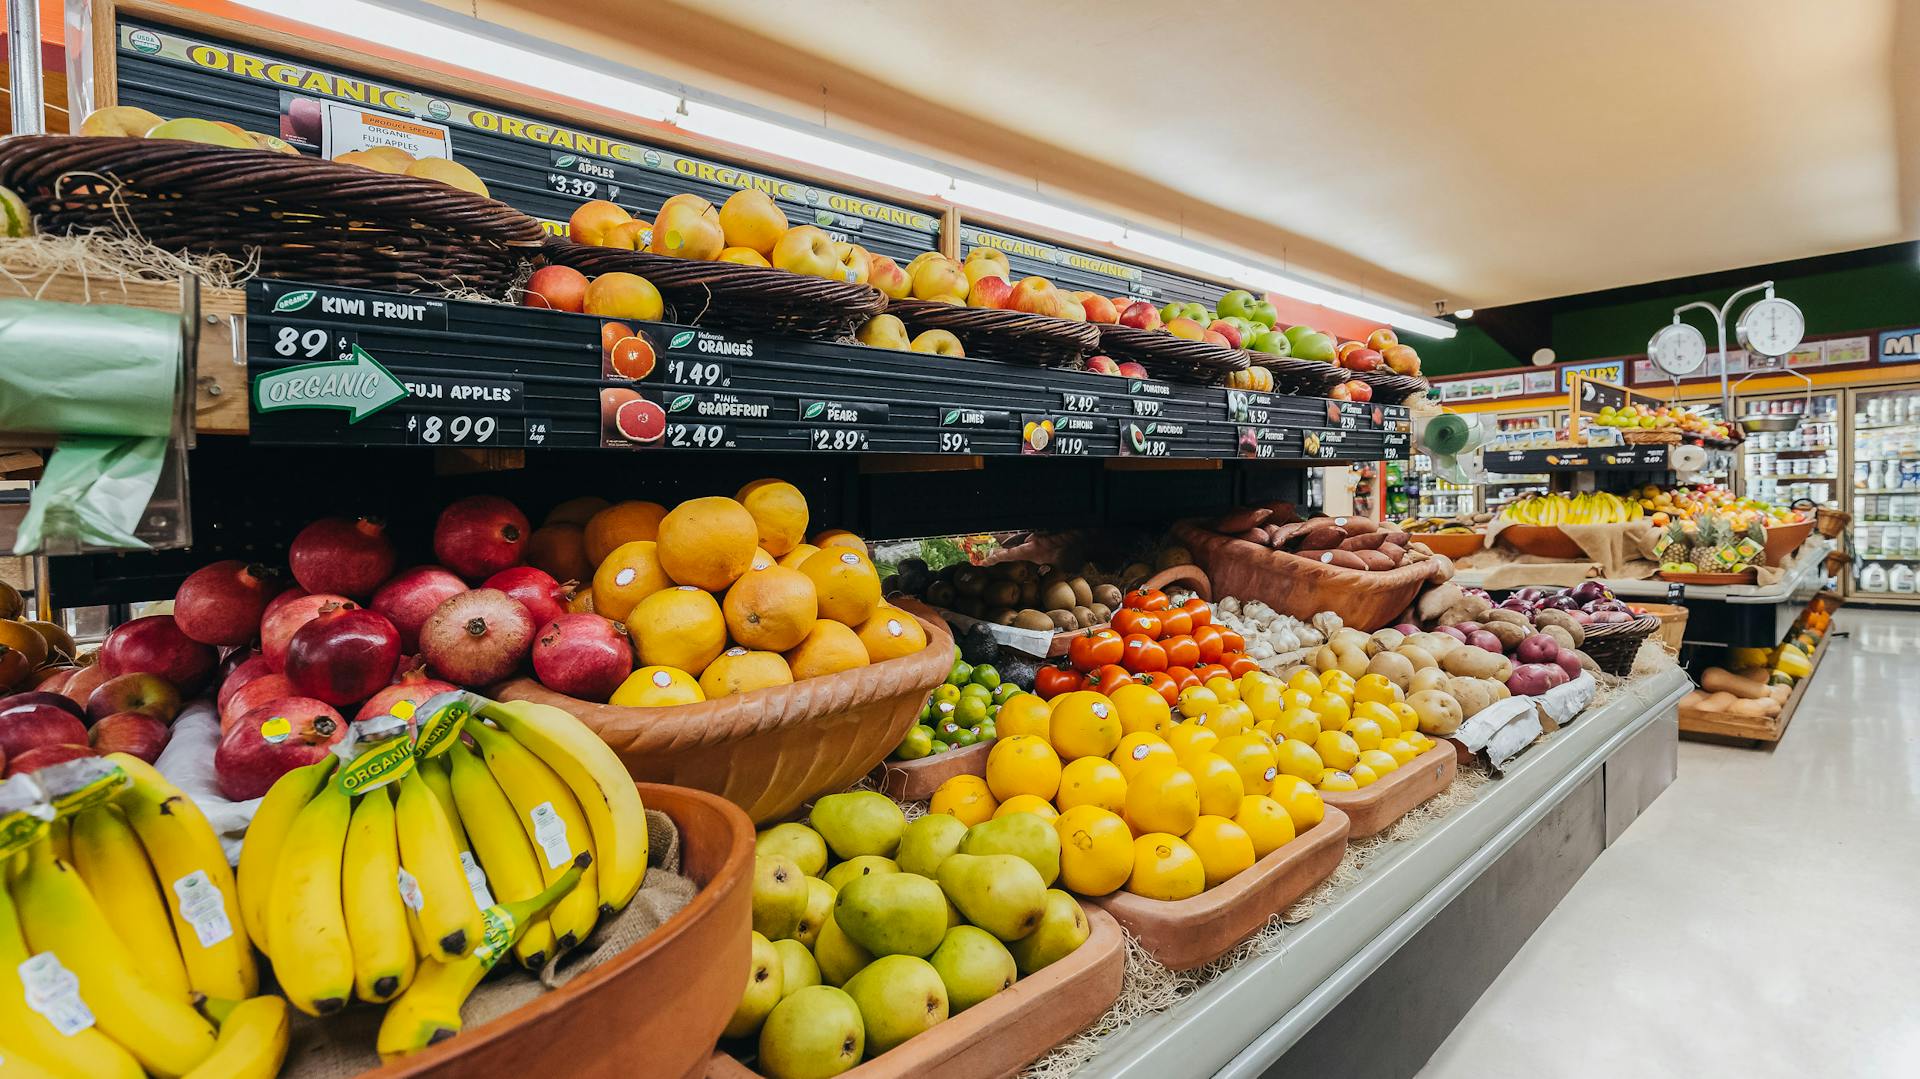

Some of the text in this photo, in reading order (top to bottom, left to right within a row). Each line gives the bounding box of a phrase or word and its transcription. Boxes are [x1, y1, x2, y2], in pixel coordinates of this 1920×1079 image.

[187, 45, 410, 112] ORGANIC
[368, 125, 412, 139] ORGANIC
[370, 117, 438, 136] PRODUCE SPECIAL
[468, 110, 631, 161] ORGANIC
[363, 134, 382, 144] FUJI
[385, 139, 419, 152] APPLES
[578, 162, 615, 179] APPLES
[674, 158, 797, 199] ORGANIC
[551, 174, 596, 197] $3.39
[829, 194, 924, 229] ORGANIC
[977, 233, 1048, 260] ORGANIC
[1069, 254, 1131, 279] ORGANIC
[279, 293, 309, 309] ORGANIC
[321, 296, 427, 321] KIWI FRUIT
[274, 327, 328, 358] 89
[698, 331, 725, 340] Valencia
[698, 339, 754, 357] ORANGES
[668, 360, 721, 386] $1.49
[268, 371, 380, 402] ORGANIC
[406, 382, 511, 402] FUJI APPLES
[1142, 383, 1170, 395] TOMATOES
[714, 393, 738, 403] PINK
[698, 401, 770, 418] GRAPEFRUIT
[827, 409, 858, 422] PEARS
[961, 413, 985, 424] LIMES
[1069, 420, 1094, 430] LEMONS
[1156, 424, 1184, 434] AVOCADOS
[530, 432, 545, 444] bag
[667, 424, 724, 448] $2.49
[814, 429, 858, 450] $2.89
[942, 433, 962, 452] 59
[415, 708, 461, 757] ORGANC
[343, 740, 413, 789] ORGANIC
